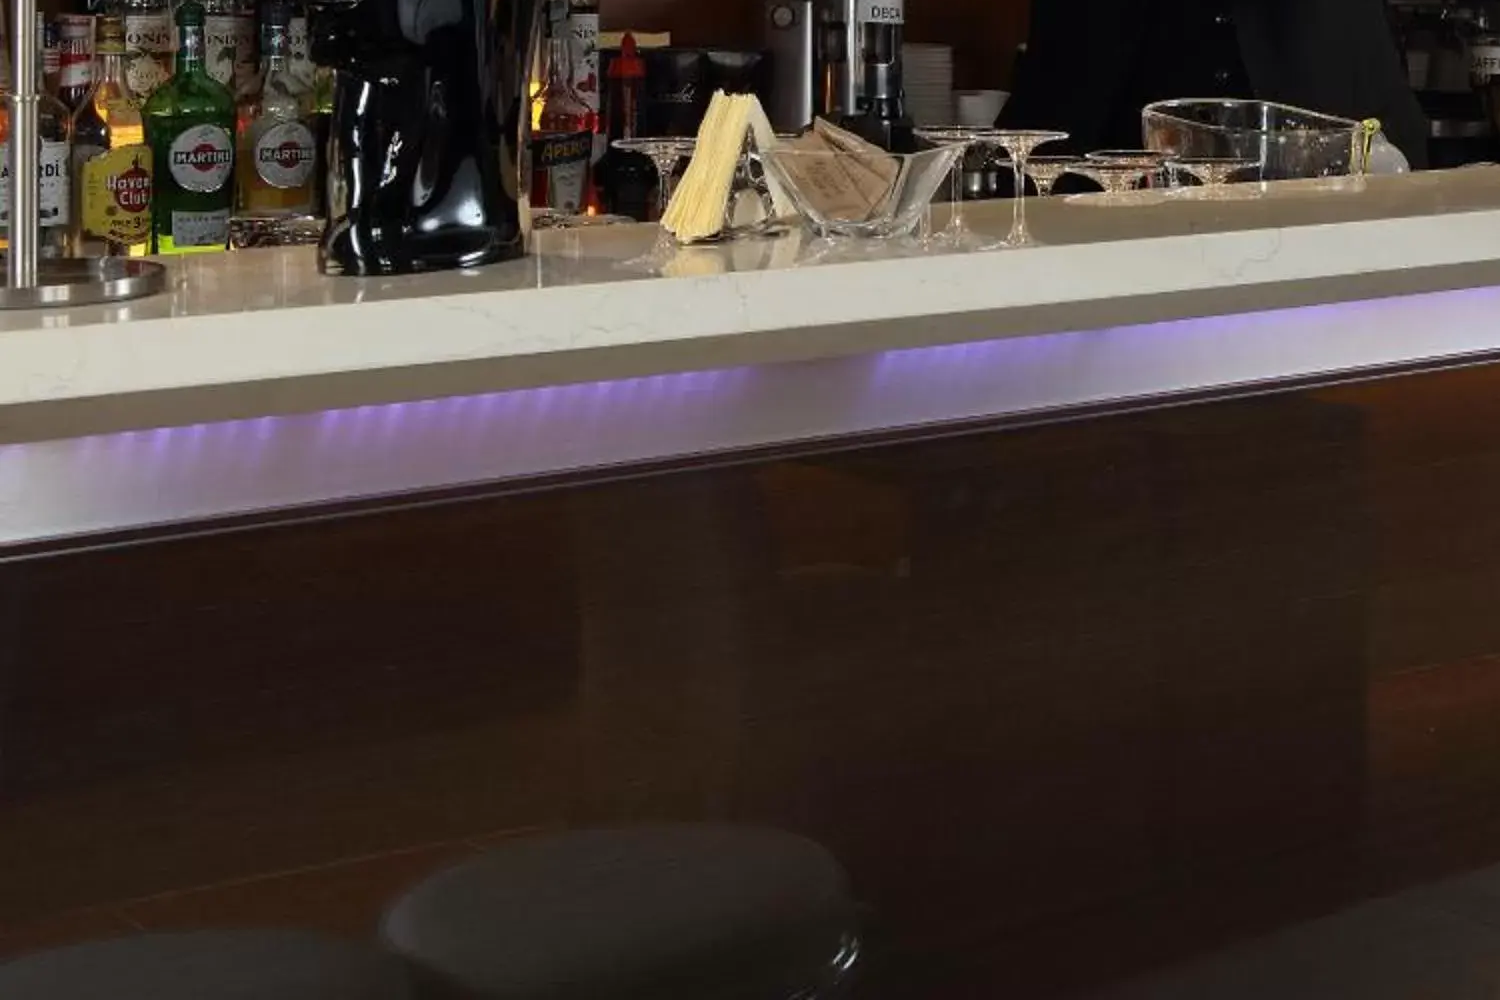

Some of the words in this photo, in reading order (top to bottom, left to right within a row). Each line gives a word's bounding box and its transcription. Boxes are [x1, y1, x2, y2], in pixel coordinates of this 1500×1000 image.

[176, 152, 230, 165] MARTINI
[260, 148, 313, 162] MARTIN
[106, 174, 150, 191] Havan
